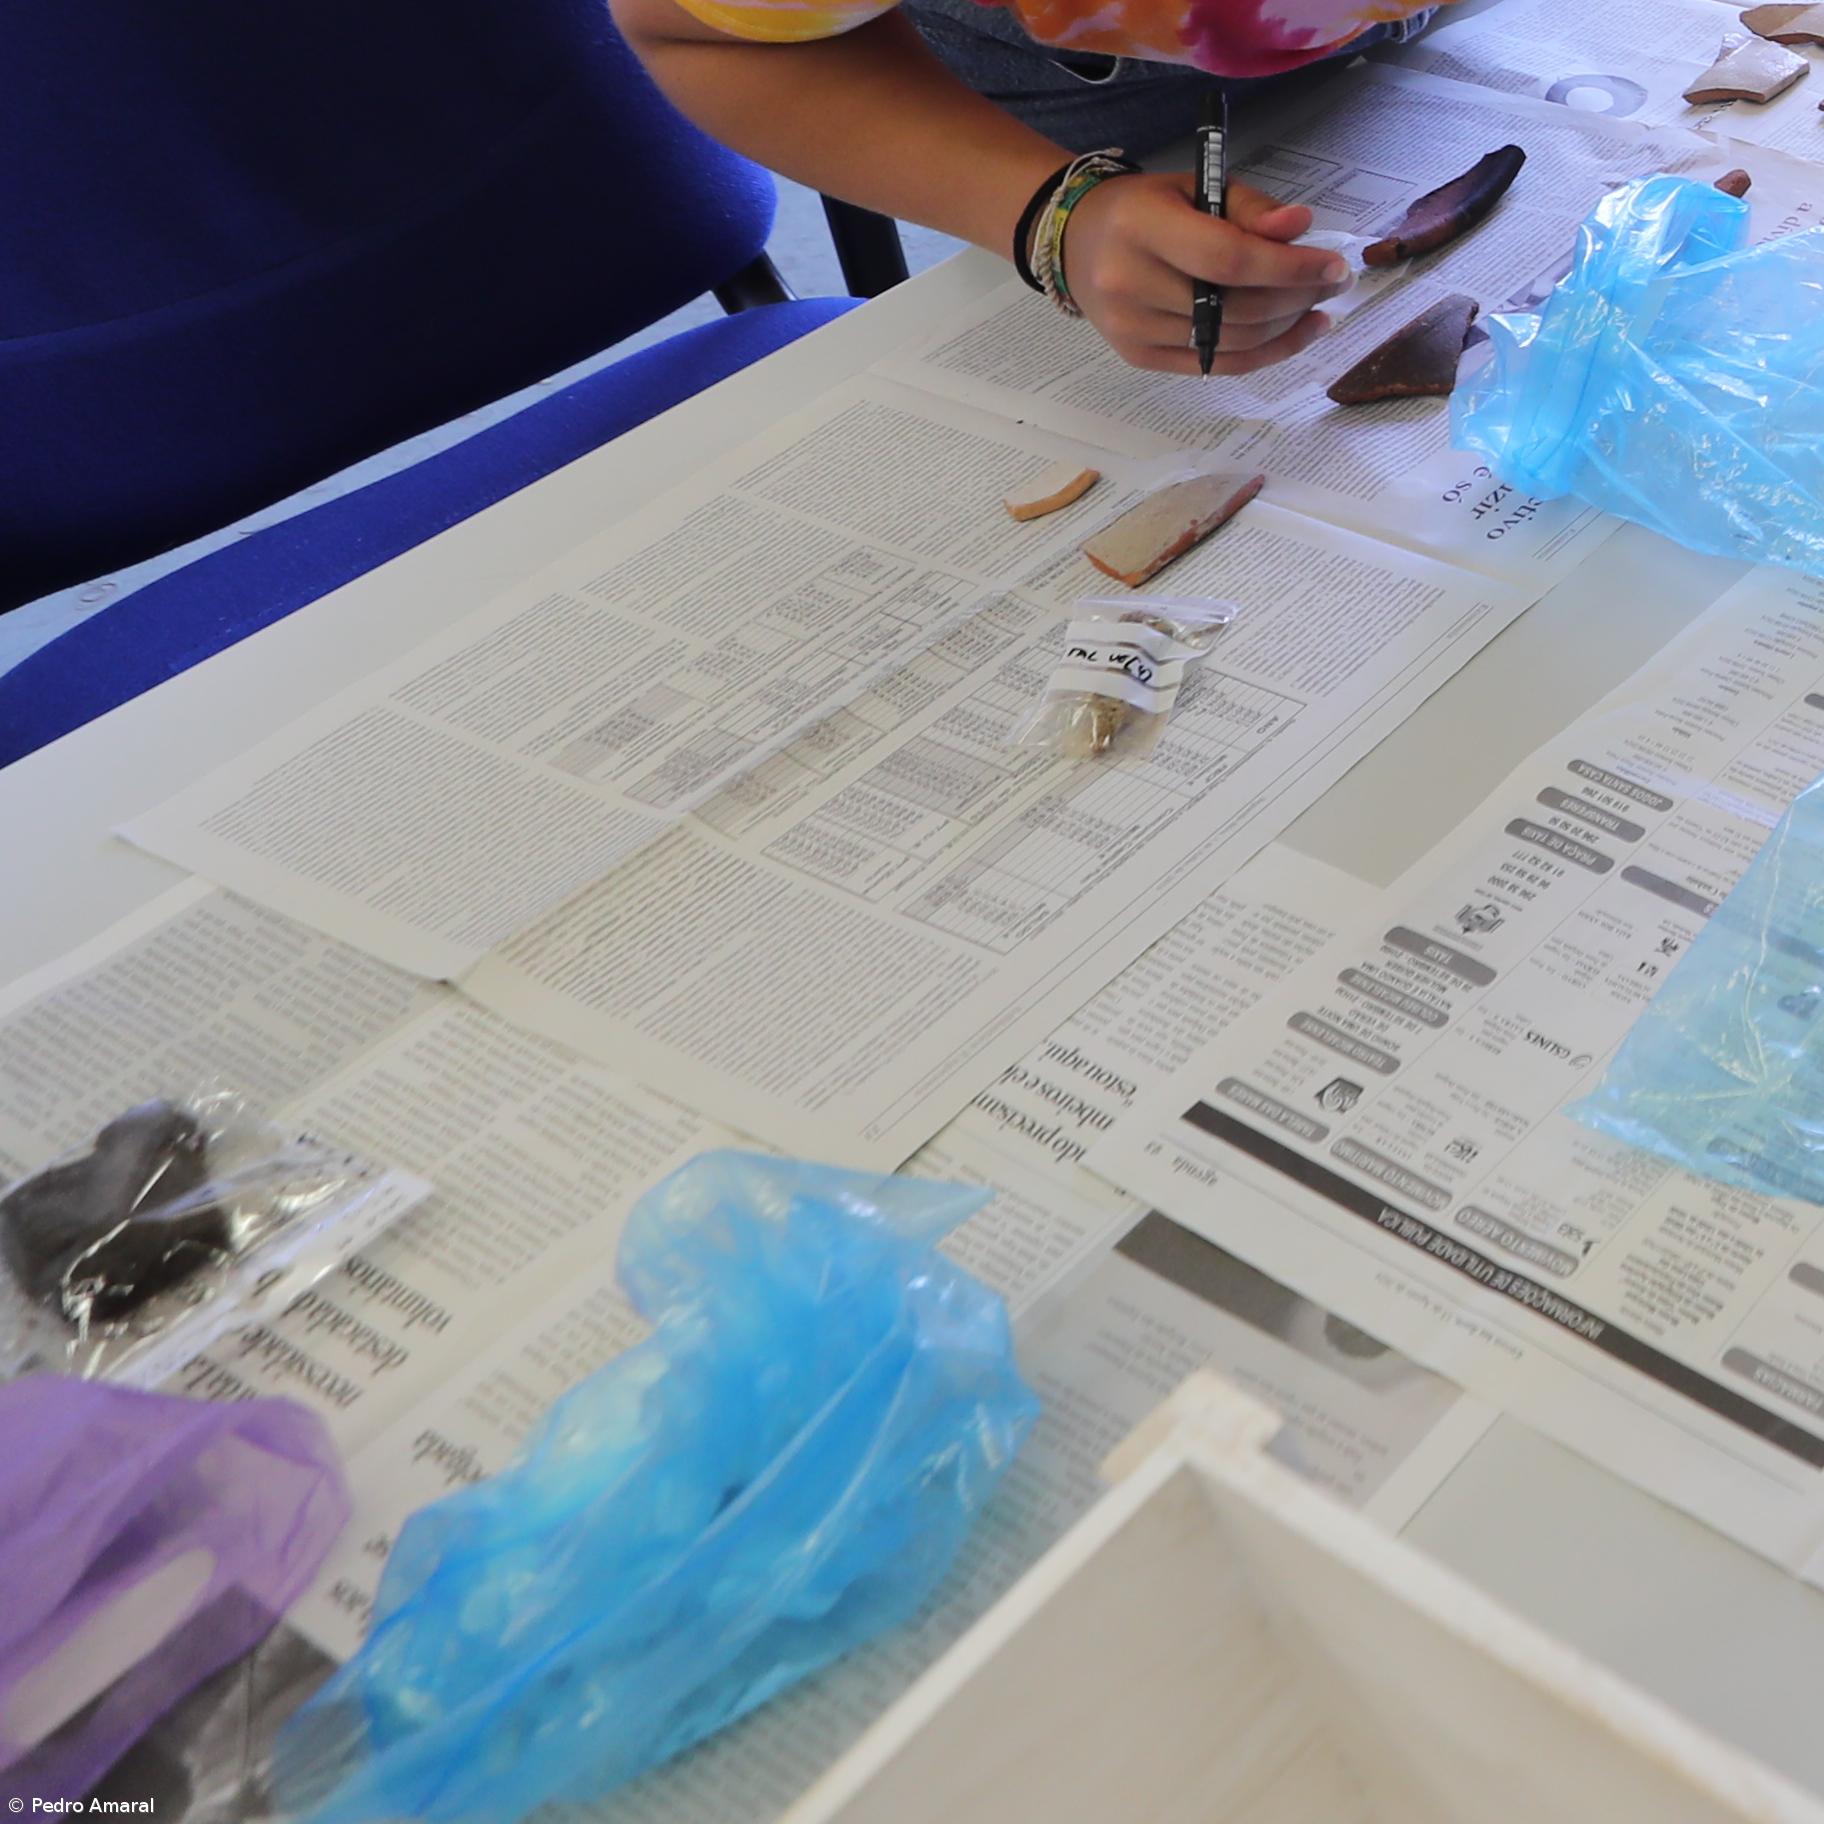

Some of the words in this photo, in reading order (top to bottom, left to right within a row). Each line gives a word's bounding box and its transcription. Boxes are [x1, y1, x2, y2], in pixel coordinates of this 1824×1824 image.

[1472, 466, 1492, 480] é
[1441, 480, 1472, 504] só
[1576, 763, 1605, 783] CASA
[1602, 774, 1634, 795] SANTA
[1631, 785, 1664, 807] JOGOS
[1548, 838, 1564, 850] DE
[1563, 842, 1598, 866] PRAÇA
[1523, 1030, 1572, 1060] GSLINES
[1035, 1081, 1116, 1132] mbeiros
[1171, 1157, 1217, 1187] agenda
[1377, 1208, 1433, 1244] PÚBLICA
[1427, 1235, 1495, 1282] UTILIDADE
[1490, 1270, 1511, 1289] DE
[1507, 1278, 1604, 1339] INFORMAÇÕES
[279, 1290, 409, 1379] destacad
[1752, 1367, 1824, 1412] FARMÁCIAS
